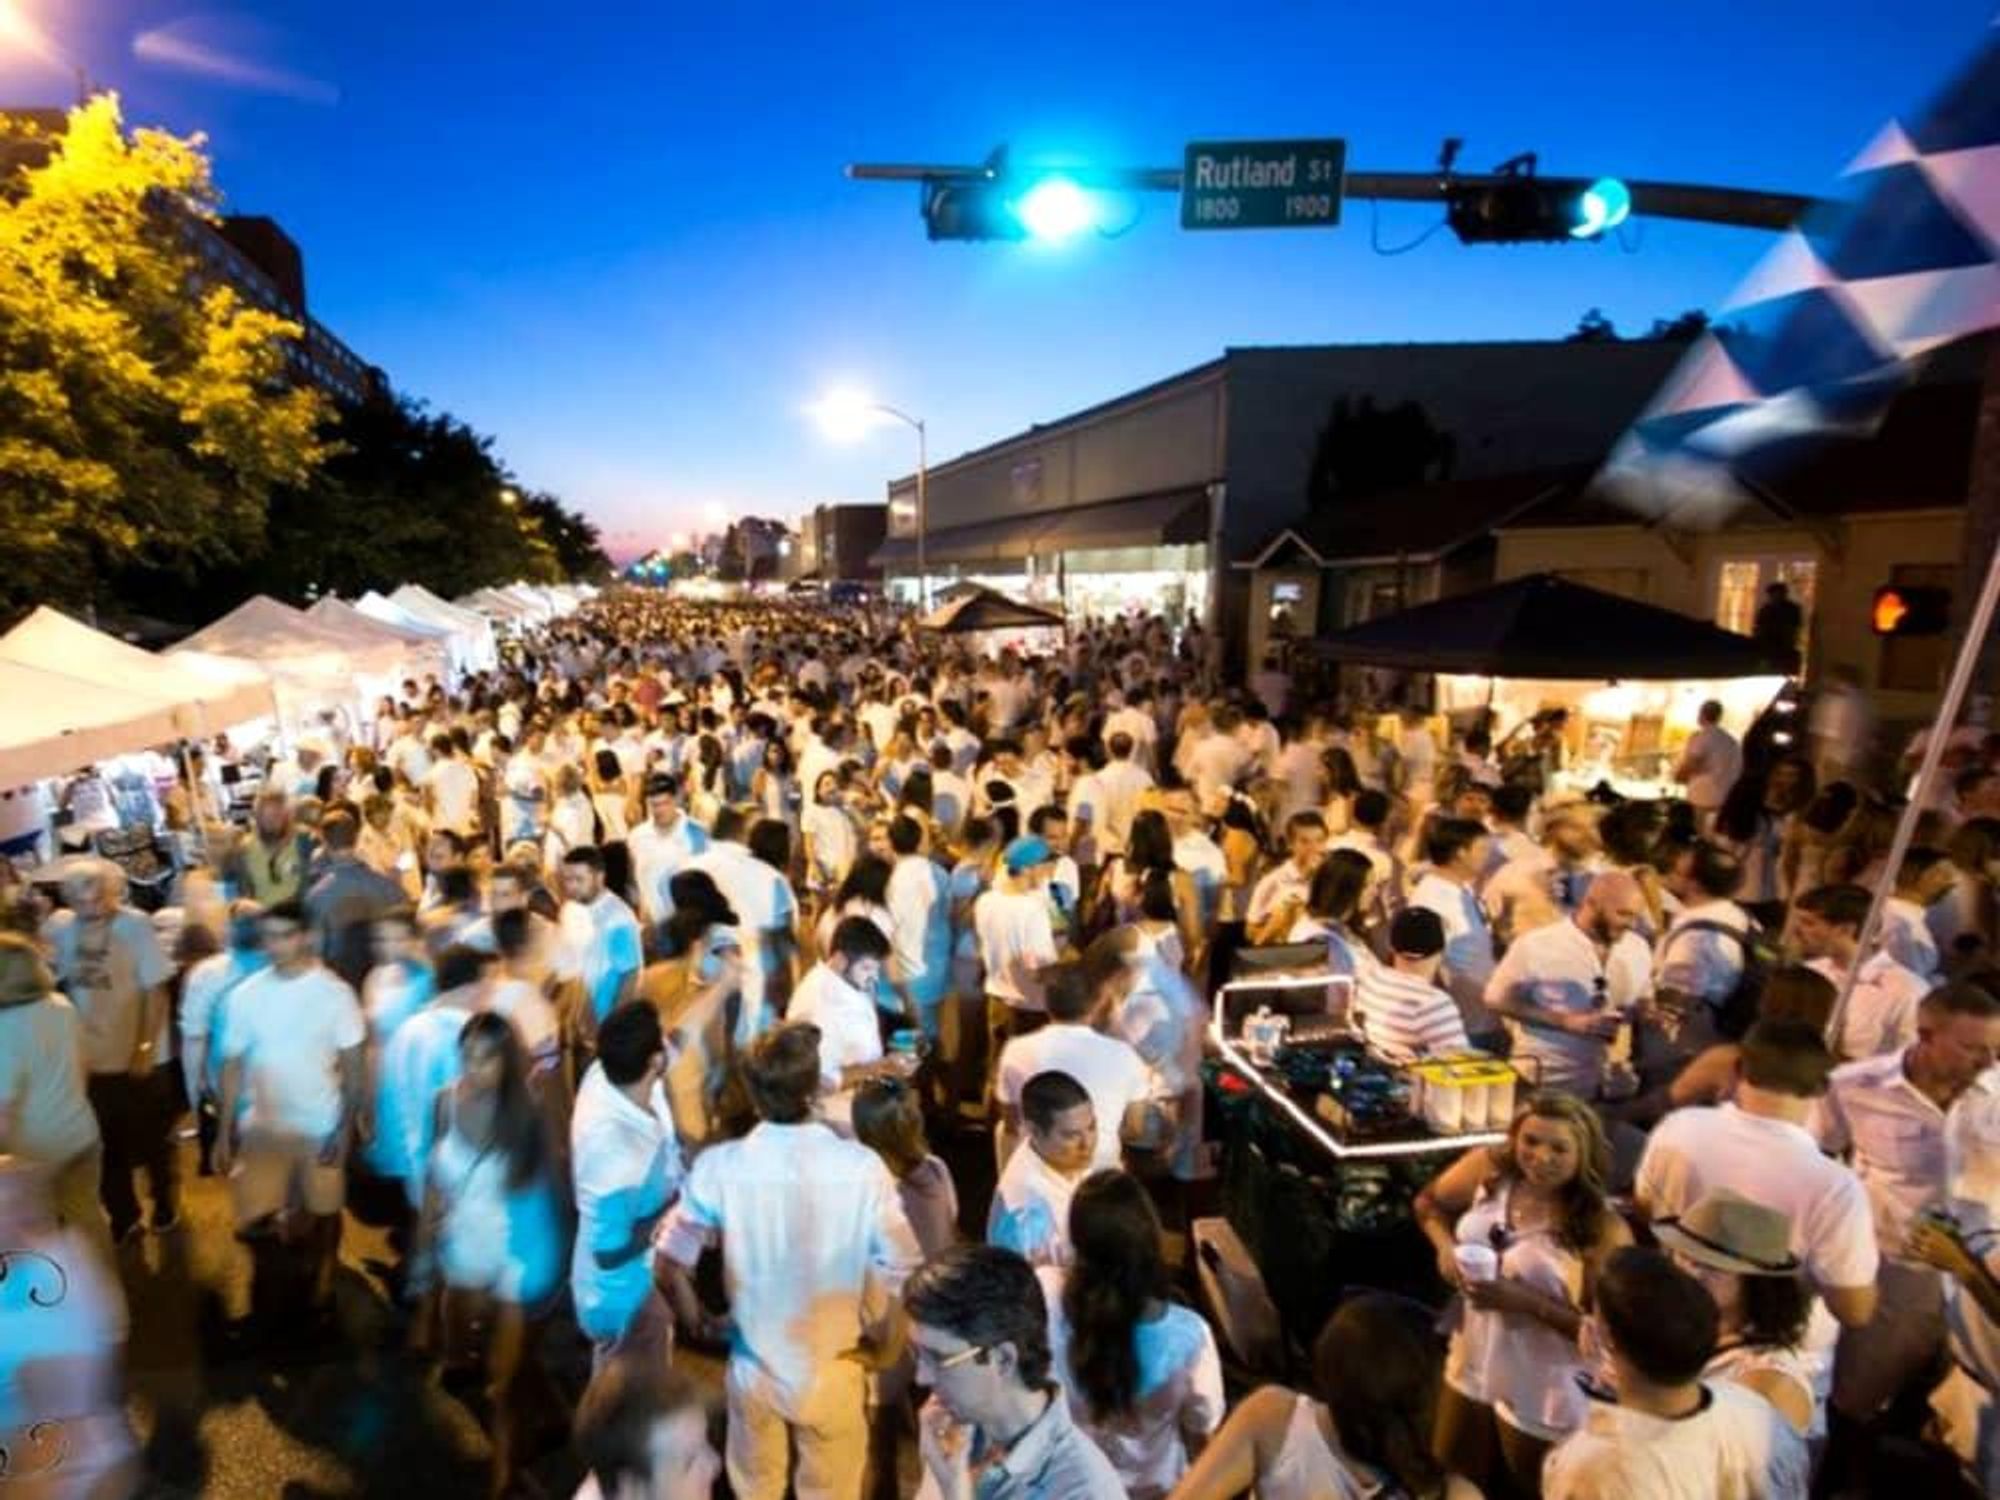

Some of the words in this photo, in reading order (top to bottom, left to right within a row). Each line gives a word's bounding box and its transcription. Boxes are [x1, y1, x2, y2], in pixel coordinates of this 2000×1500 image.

[1195, 154, 1297, 189] Rutland
[1308, 159, 1333, 182] St
[1196, 196, 1240, 220] 1800
[1285, 195, 1330, 218] 1900
